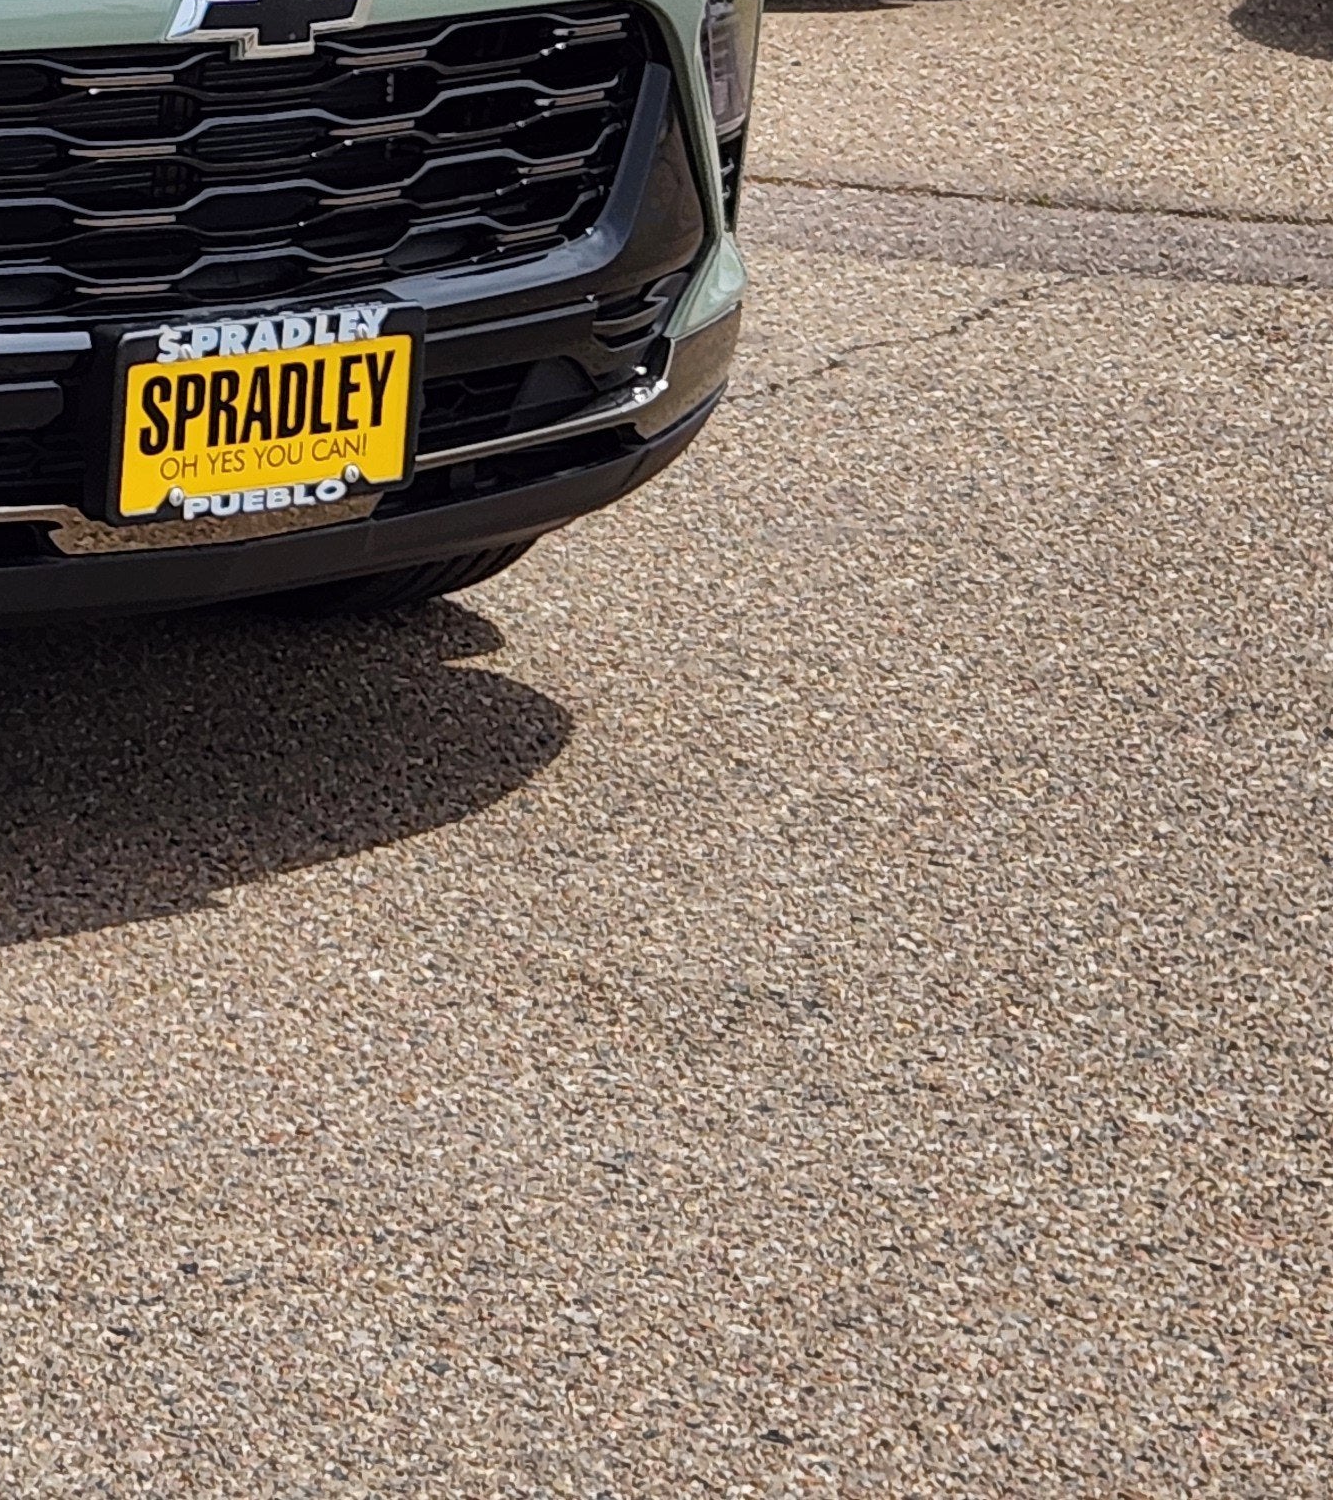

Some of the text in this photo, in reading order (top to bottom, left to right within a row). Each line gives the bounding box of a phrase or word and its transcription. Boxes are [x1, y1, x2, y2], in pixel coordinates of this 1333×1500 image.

[156, 304, 389, 363] SPRADLEY
[138, 349, 396, 457] SPRADLEY
[159, 432, 368, 481] OH YES YOU CAN!
[183, 478, 348, 520] PUEBLO
